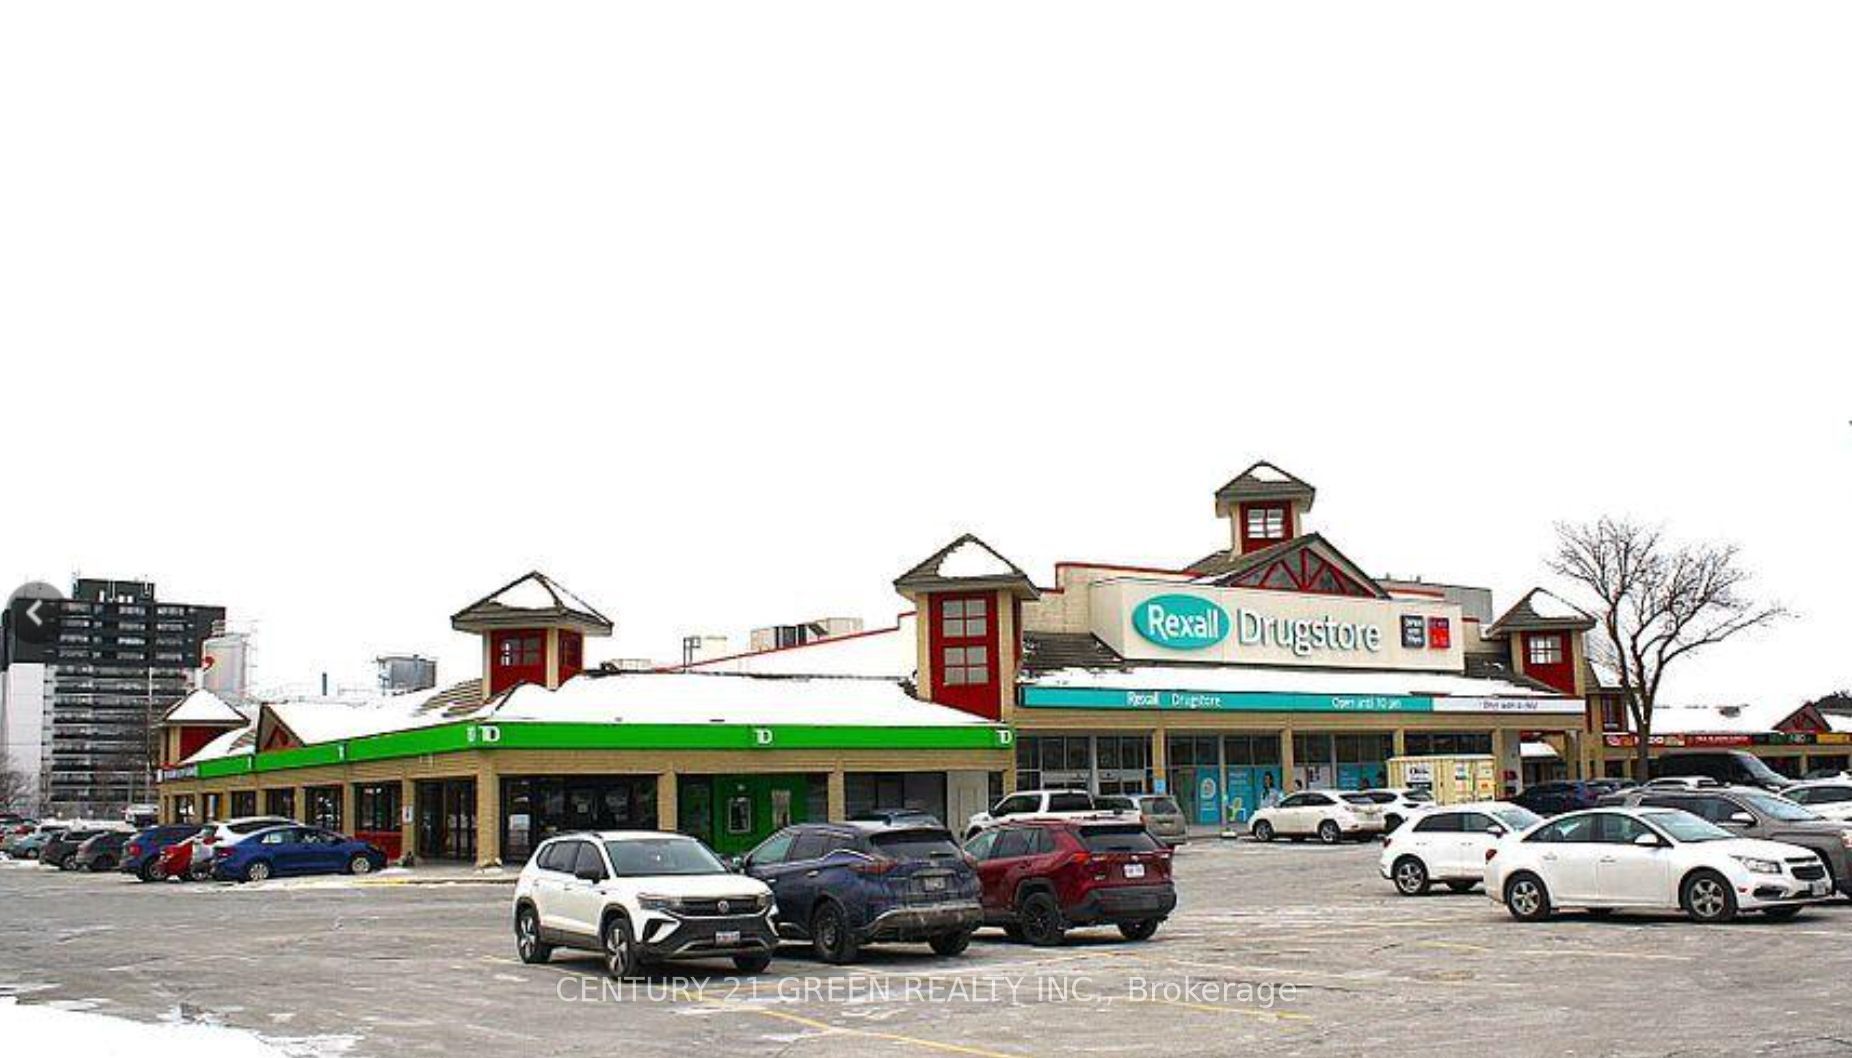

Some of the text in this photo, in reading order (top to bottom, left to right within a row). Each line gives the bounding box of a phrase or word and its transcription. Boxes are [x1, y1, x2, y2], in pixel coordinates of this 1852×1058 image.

[1148, 604, 1219, 641] Rexall
[1237, 608, 1382, 656] Drugstore
[1126, 691, 1222, 709] Rexall Drugstore
[478, 725, 500, 742] TD
[753, 728, 773, 744] TD
[996, 730, 1013, 744] TD
